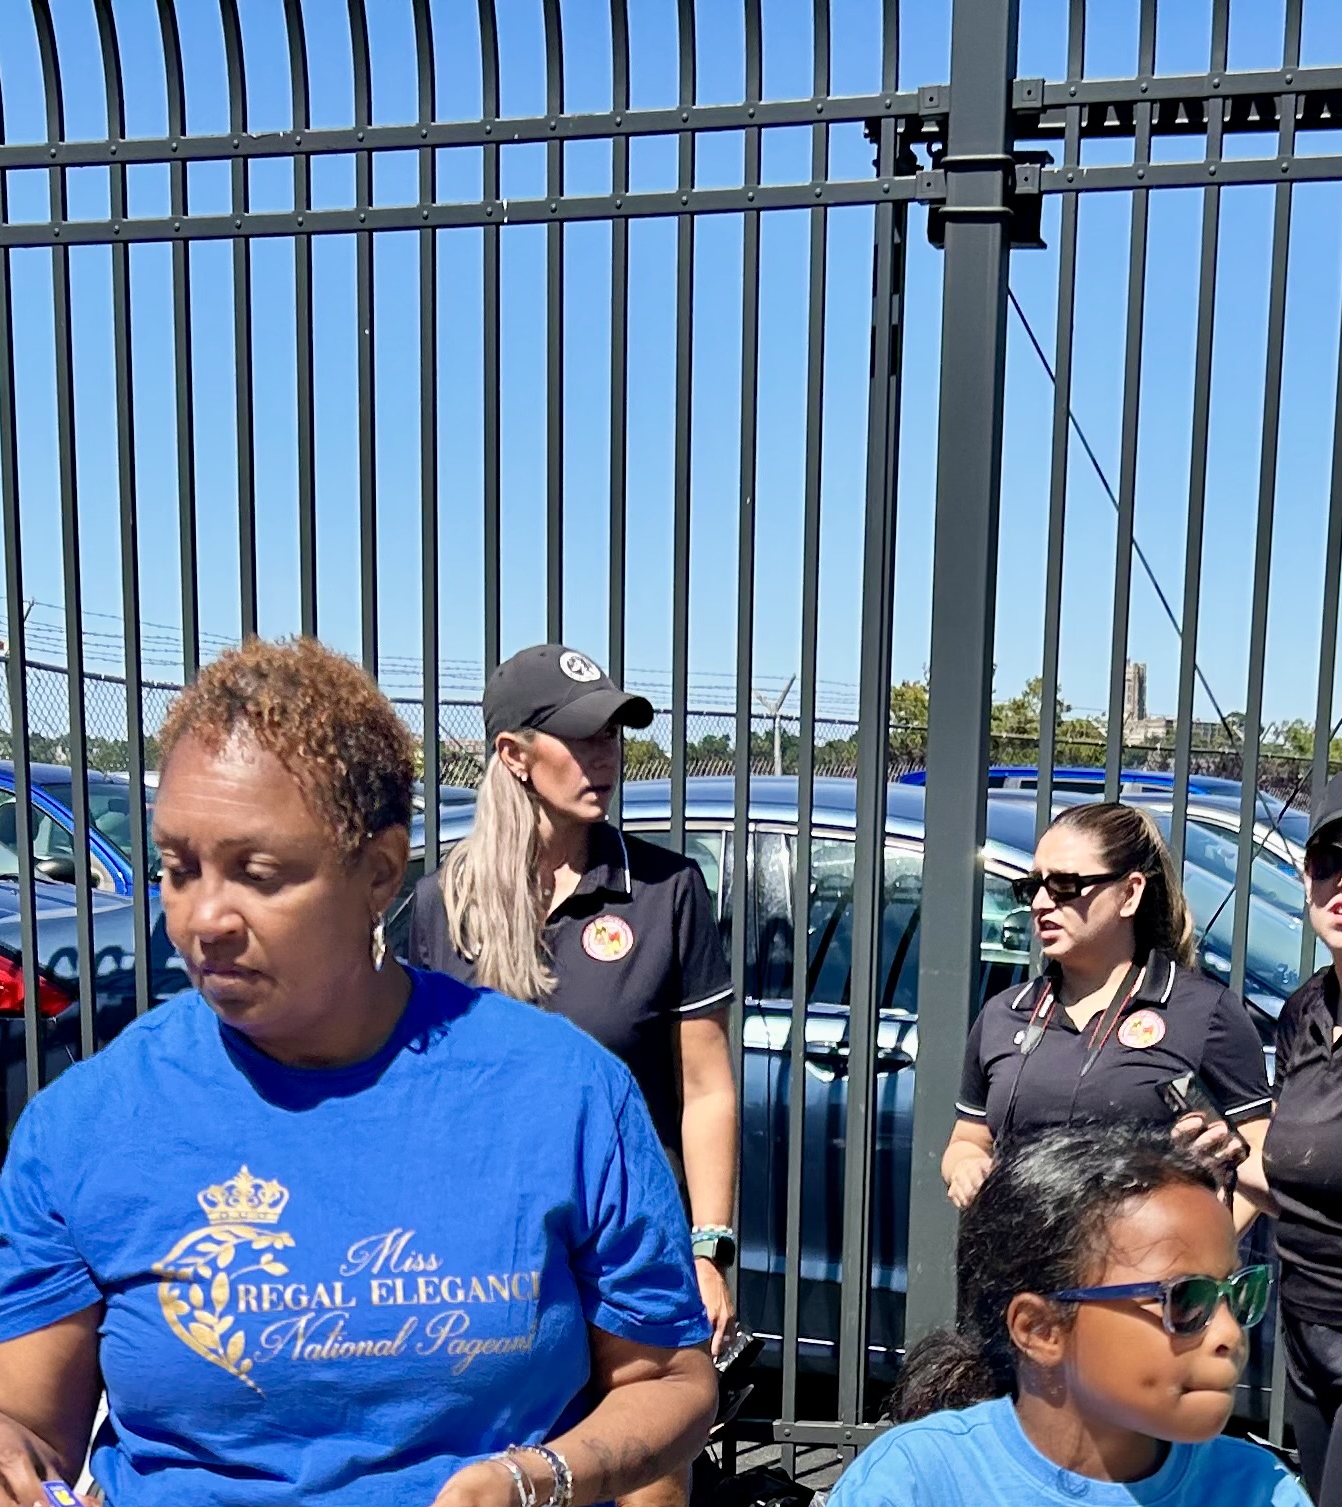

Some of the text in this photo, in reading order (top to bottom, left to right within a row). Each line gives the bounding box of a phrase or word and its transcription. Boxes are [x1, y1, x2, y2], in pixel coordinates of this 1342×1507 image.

[339, 1226, 444, 1279] Miss
[237, 1282, 357, 1313] REGAL
[253, 1308, 419, 1363] National
